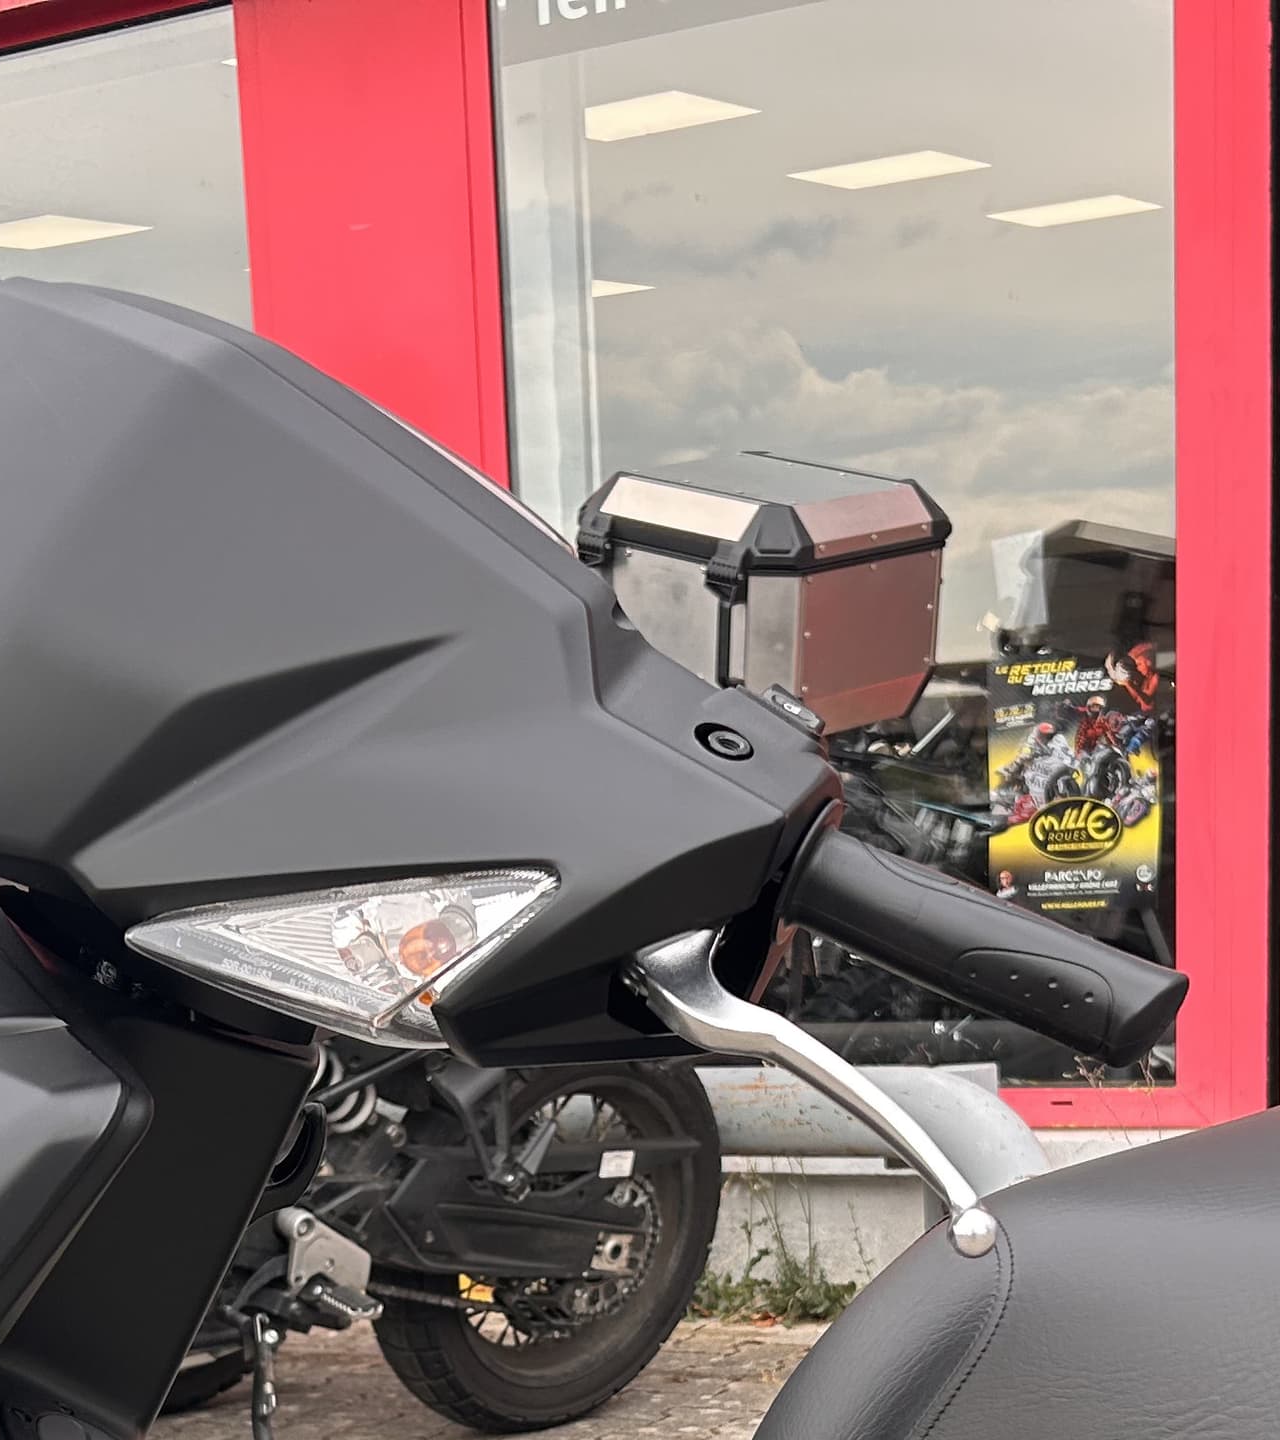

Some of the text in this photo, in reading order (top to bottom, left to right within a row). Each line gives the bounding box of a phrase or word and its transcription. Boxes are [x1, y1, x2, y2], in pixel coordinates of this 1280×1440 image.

[1008, 660, 1077, 677] RETOUR
[1022, 670, 1079, 687] SALON
[1031, 678, 1114, 696] MOTARDS
[1047, 830, 1088, 841] ROUES
